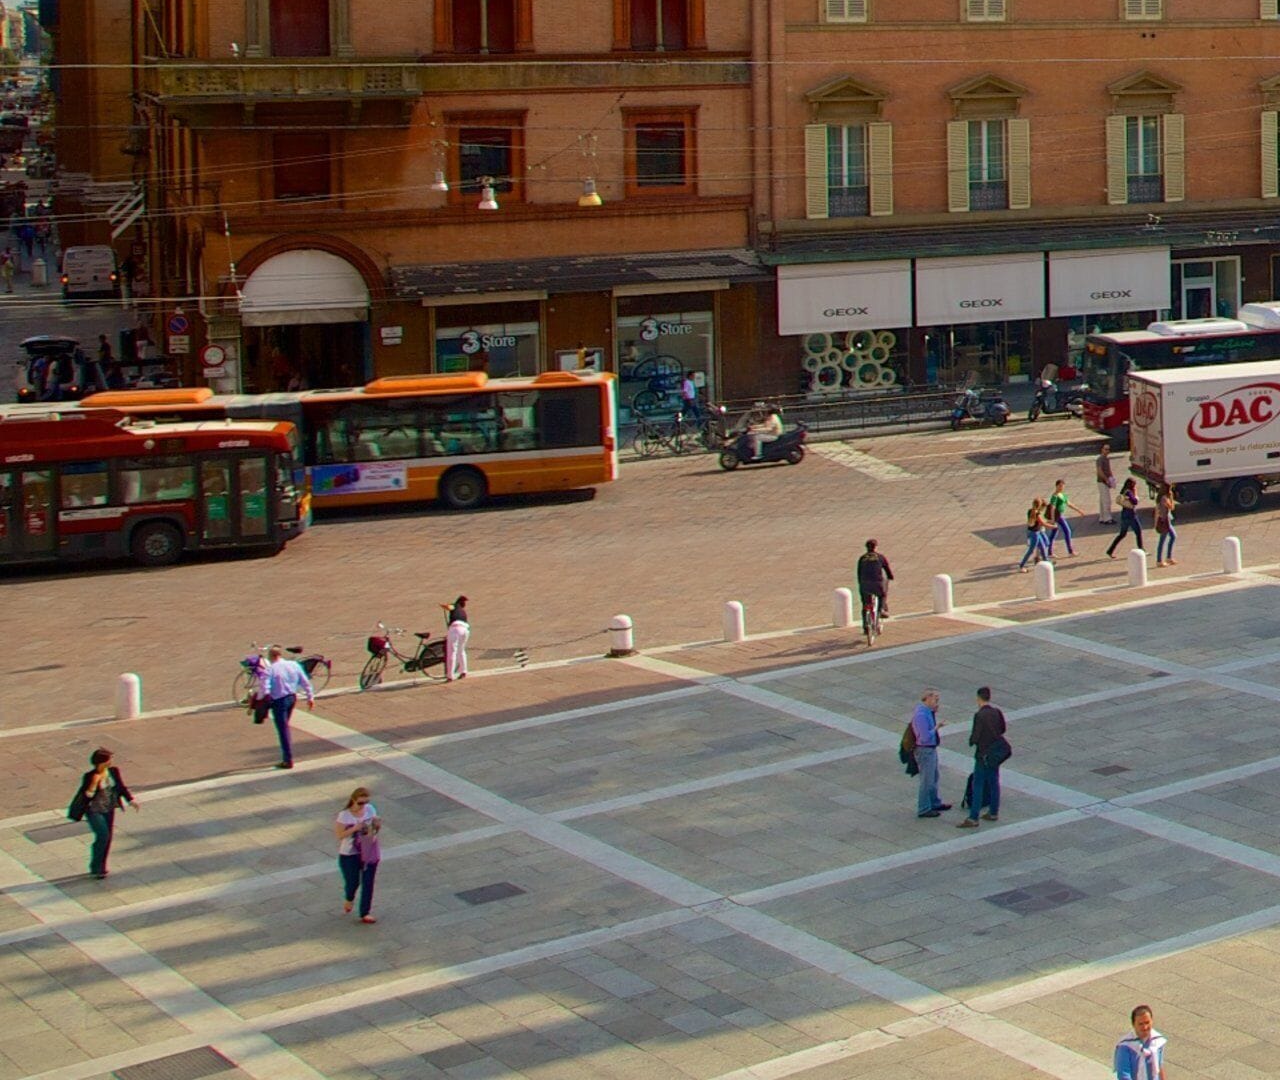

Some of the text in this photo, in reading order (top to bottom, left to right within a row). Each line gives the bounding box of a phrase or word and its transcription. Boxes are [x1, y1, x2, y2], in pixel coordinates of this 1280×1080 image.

[1089, 289, 1132, 300] GEOX
[959, 298, 1003, 309] GEOX
[823, 306, 869, 318] GEOX
[641, 318, 693, 341] 3 Store
[461, 331, 516, 354] 3 Store
[1199, 395, 1273, 429] DAC
[1225, 445, 1238, 455] per
[1239, 443, 1246, 451] la
